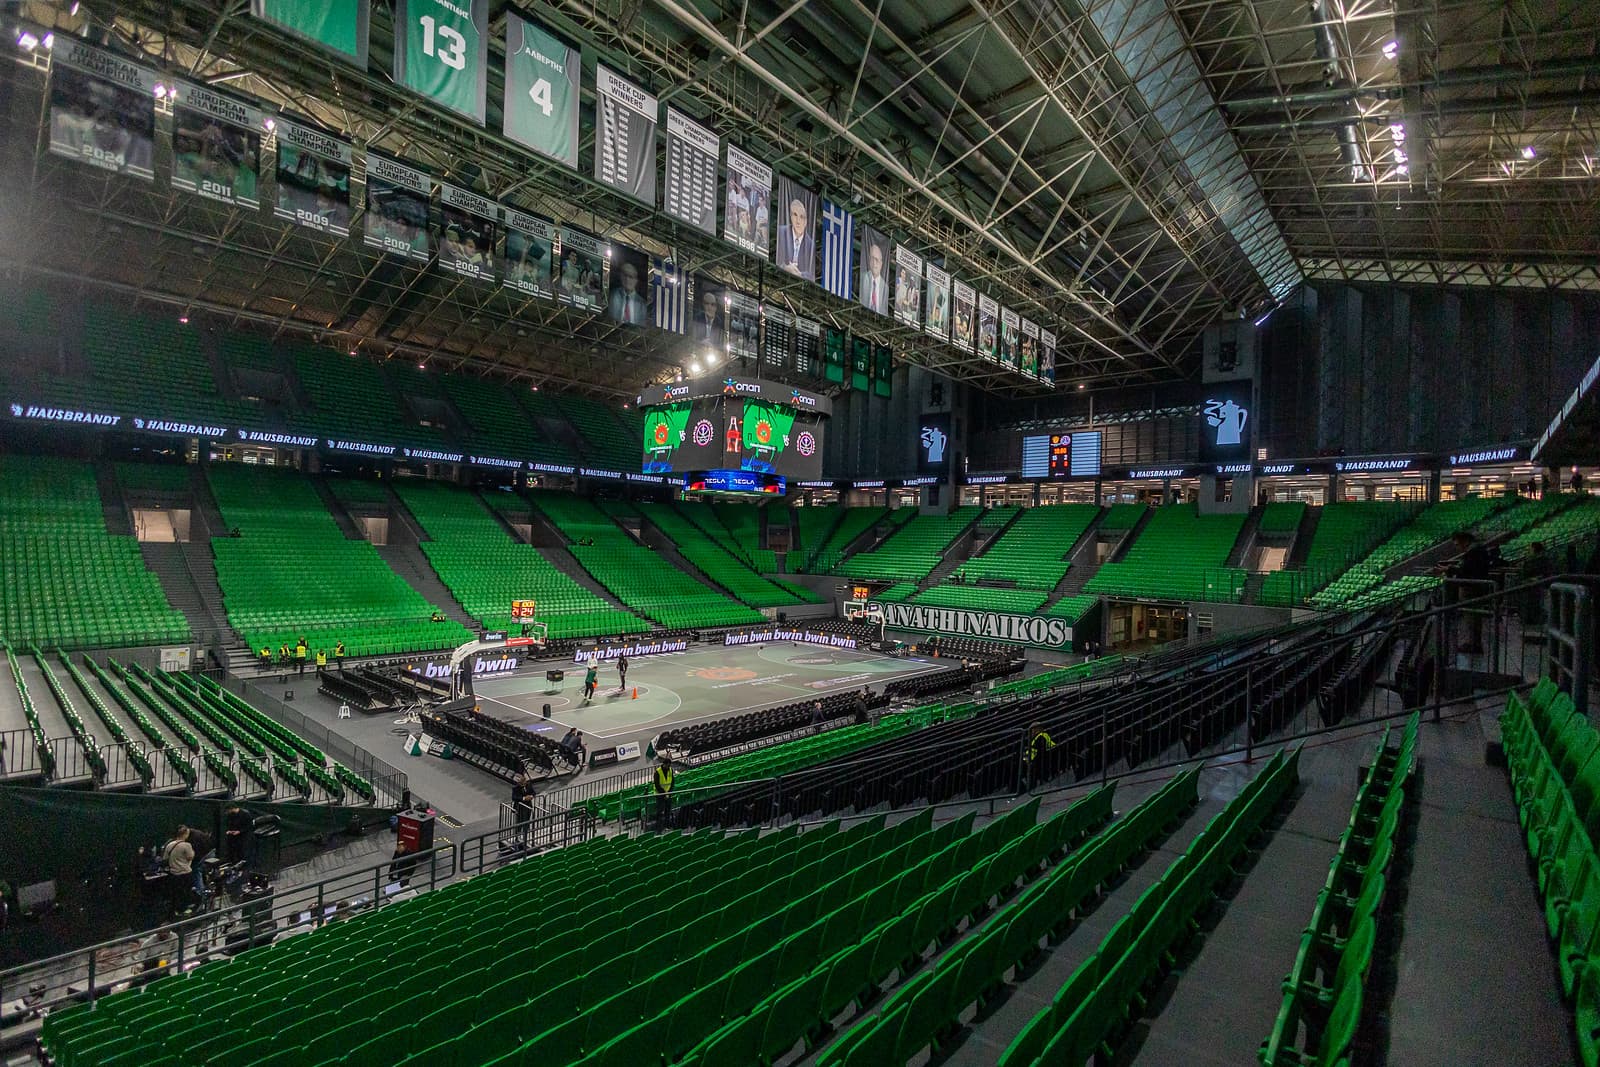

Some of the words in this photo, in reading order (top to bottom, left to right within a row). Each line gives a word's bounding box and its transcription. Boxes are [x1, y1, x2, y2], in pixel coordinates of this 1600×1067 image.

[420, 15, 466, 71] 13
[68, 53, 143, 88] CHAMPIONS
[73, 45, 139, 77] EUROPEAN
[528, 77, 553, 117] 4
[608, 75, 632, 94] GREEK
[632, 89, 646, 101] CUP
[611, 85, 643, 110] WINNERS
[186, 95, 249, 125] CHAMPIONS
[190, 87, 246, 115] EUROPEAN
[287, 133, 342, 159] CHAMPIONS
[291, 126, 338, 150] EUROPEAN
[82, 144, 125, 166] 2024
[375, 166, 422, 190] CHAMPIONS
[378, 160, 420, 181] EUROPEAN
[202, 179, 231, 197] 2011
[449, 195, 490, 216] CHAMPIONS
[452, 189, 488, 209] EUROPEAN
[296, 208, 329, 226] 2009
[514, 213, 546, 231] EUROPEAN
[512, 219, 548, 237] CHAMPIONS
[384, 236, 411, 251] 2007
[569, 232, 597, 247] EUROPEAN
[455, 259, 480, 274] 2002
[518, 279, 540, 293] 2000
[25, 406, 121, 426] HAUSBRANDT
[147, 419, 228, 437] HAUSBRANDT
[249, 431, 318, 447] HAUSBRANDT
[336, 440, 396, 455] HAUSBRANDT
[411, 449, 464, 462] HAUSBRANDT
[476, 456, 523, 468] HAUSBRANDT
[534, 463, 575, 474] HAUSBRANDT
[585, 469, 622, 480] HAUSBRANDT
[1136, 469, 1183, 479] HAUSBRANDT
[1344, 459, 1411, 471] HAUSBRANDT
[1458, 448, 1516, 464] HAUSBRANDT
[520, 607, 534, 617] 24
[634, 641, 660, 655] bwin
[661, 639, 687, 652] bwin
[725, 631, 749, 645] bwin
[749, 629, 773, 642] bwin
[773, 628, 803, 641] bwin
[804, 630, 830, 644] bwin
[830, 634, 857, 649] bwin
[474, 655, 518, 673] bwin
